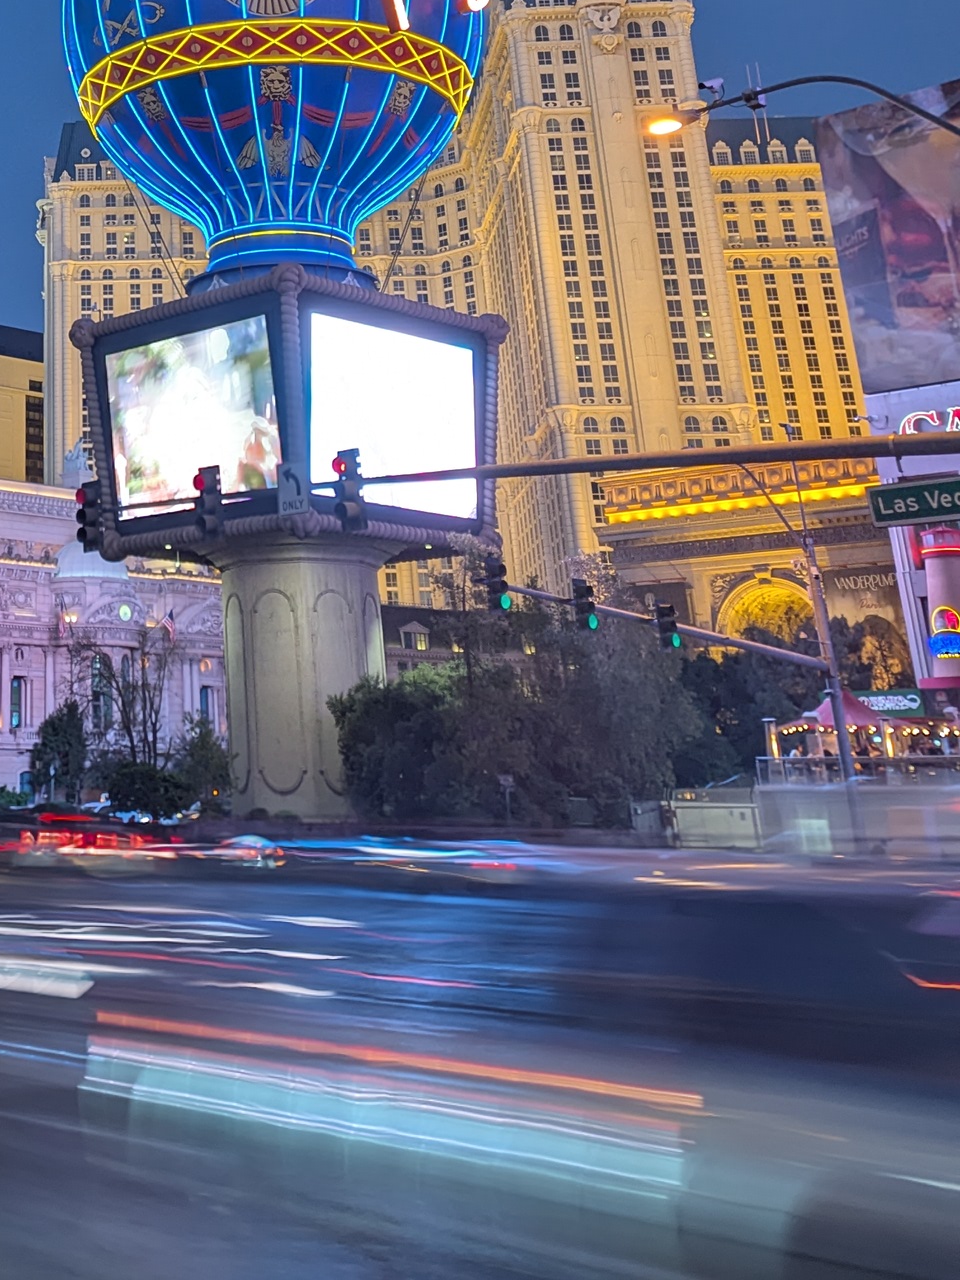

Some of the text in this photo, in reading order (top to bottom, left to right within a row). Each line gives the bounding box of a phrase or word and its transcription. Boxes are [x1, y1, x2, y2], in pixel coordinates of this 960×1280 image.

[282, 499, 304, 512] ONLY
[878, 496, 919, 515] Las
[833, 572, 898, 591] VANDERPUMP
